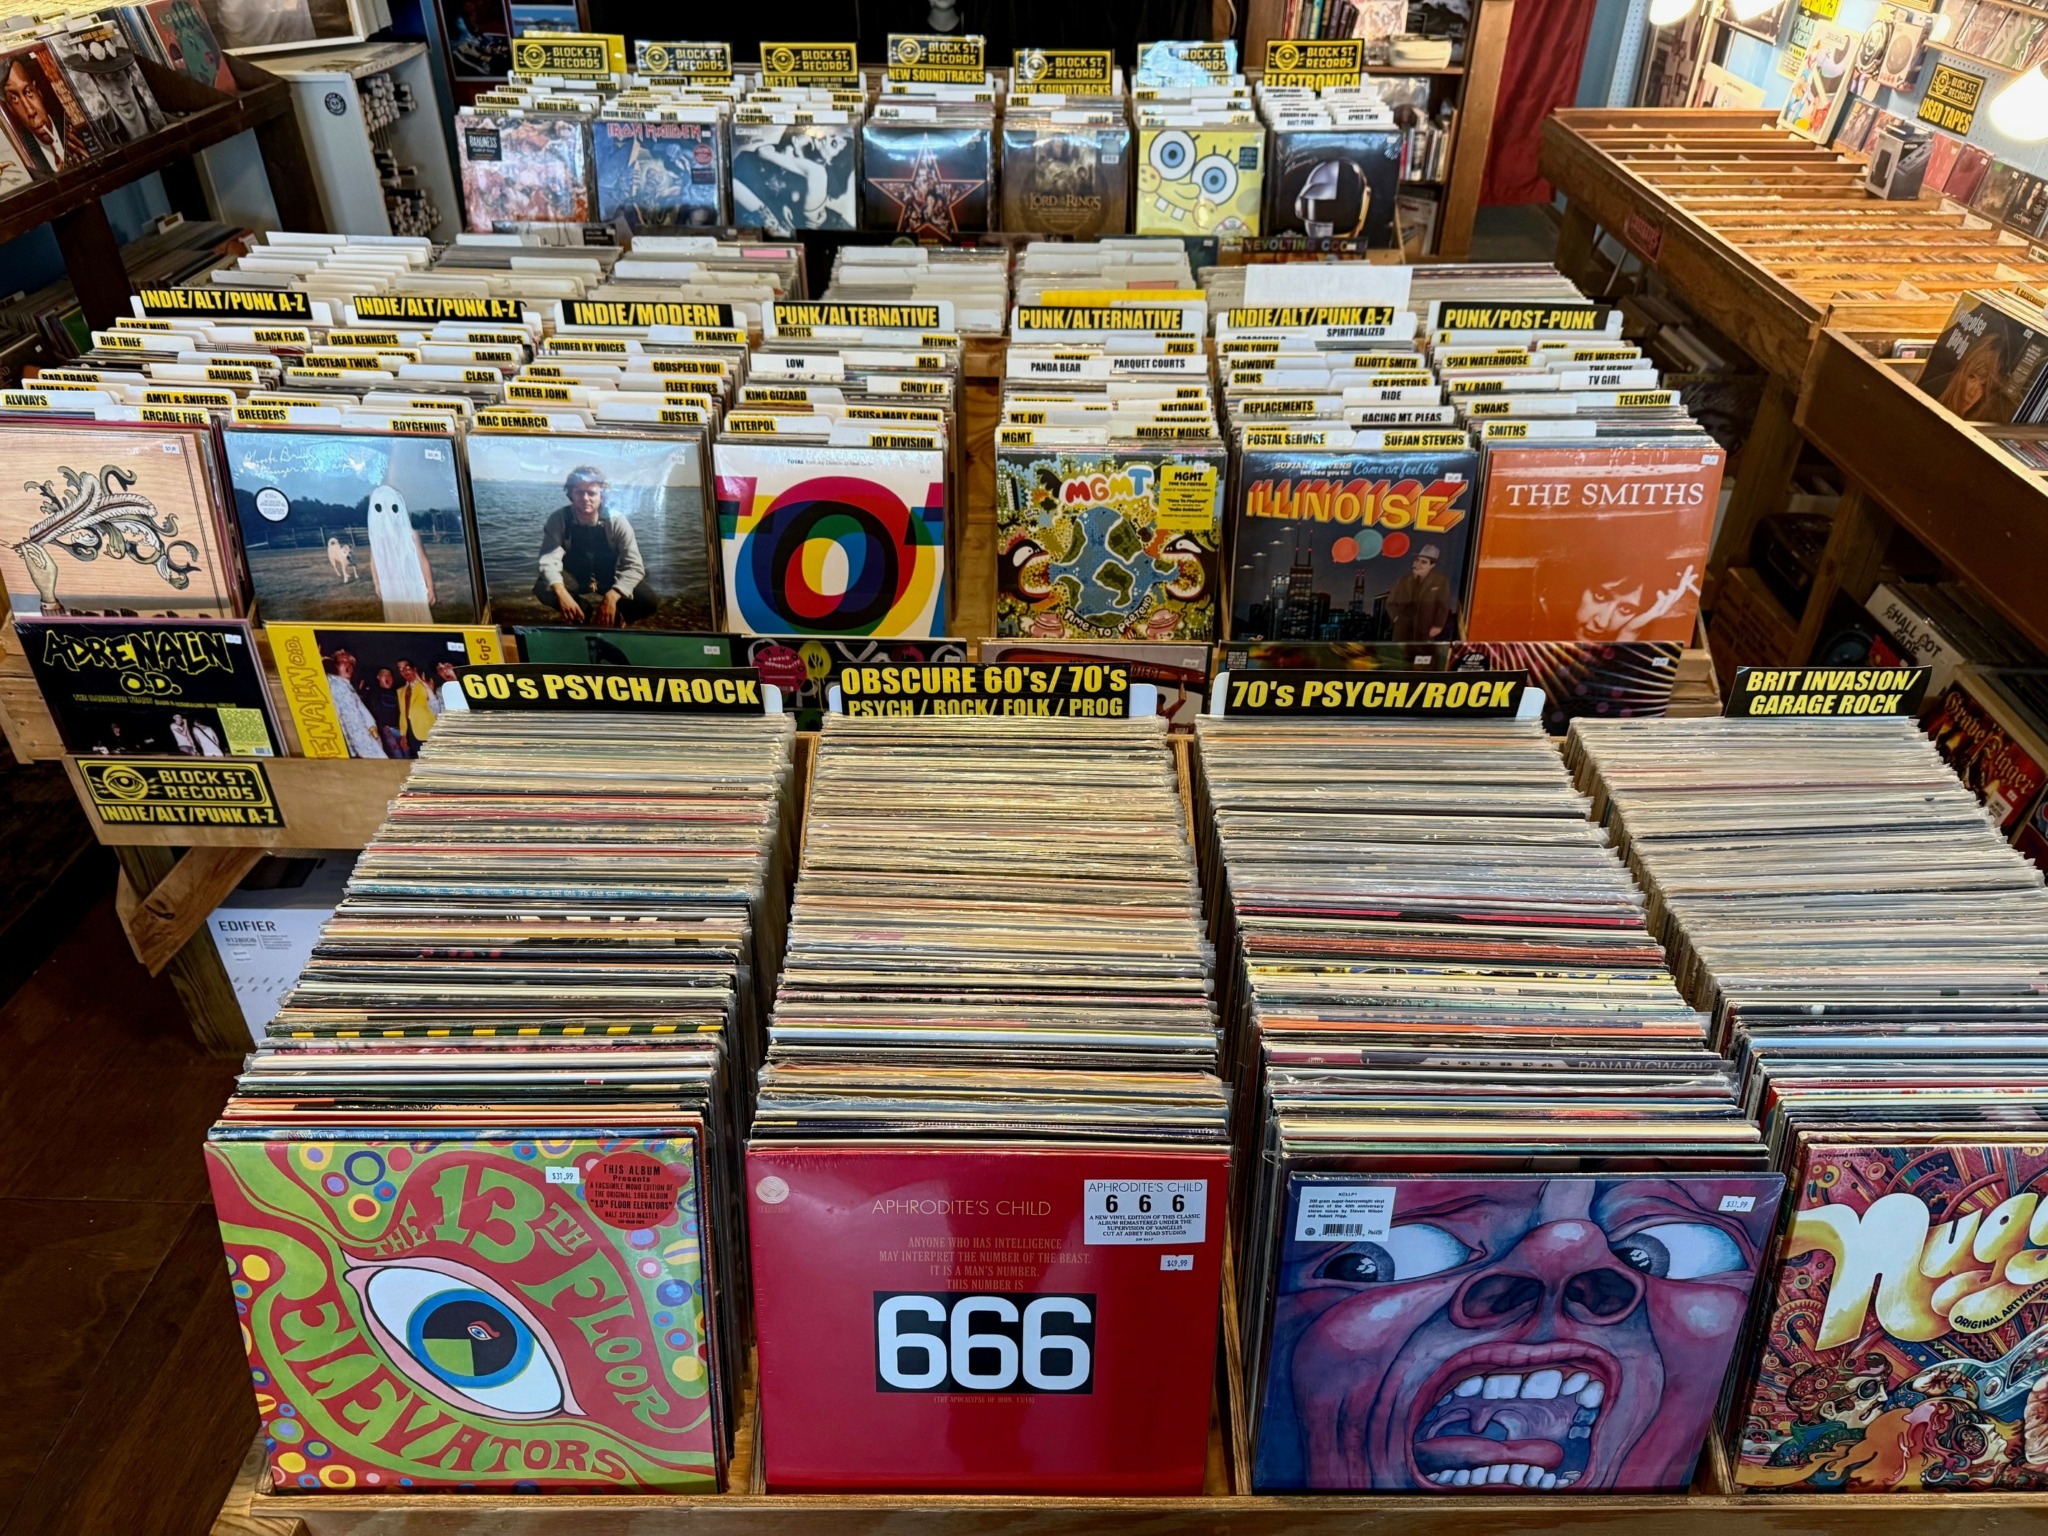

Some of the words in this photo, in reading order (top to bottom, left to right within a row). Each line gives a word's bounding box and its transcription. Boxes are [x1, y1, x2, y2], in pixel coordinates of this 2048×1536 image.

[553, 47, 584, 58] BLOCK
[585, 48, 600, 58] ST.
[676, 48, 709, 60] BLOCK
[710, 49, 725, 60] ST.
[802, 50, 834, 60] BLOCK
[835, 50, 850, 61] ST.
[1306, 46, 1338, 58] BLOCK
[1339, 46, 1356, 57] ST.
[553, 57, 600, 68] RECORDS
[676, 60, 724, 71] RECORDS
[803, 60, 849, 71] RECORDS
[928, 54, 977, 65] RECORDS
[1306, 58, 1354, 69] RECORDS
[888, 69, 911, 80] NEW
[913, 70, 984, 83] SOUNDTRACKS
[1055, 68, 1104, 79] RECORDS
[1264, 73, 1360, 88] ELECTRONICA
[1015, 84, 1039, 95] NEW
[1039, 84, 1111, 95] SOUNDTRACKS
[1948, 87, 1974, 105] RECORDS
[1919, 97, 1945, 124] USED
[1941, 103, 1973, 135] TAPES
[607, 123, 643, 142] IRON
[645, 123, 702, 144] MAIDEN
[140, 290, 276, 312] INDIE/ALT/PUNK
[279, 293, 306, 312] A-Z
[355, 296, 488, 317] INDIE/ALT/PUNK
[490, 299, 518, 319] A-Z
[574, 302, 721, 326] INDIE/MODERN
[775, 306, 938, 327] PUNK/ALTERNATIVE
[1019, 310, 1182, 329] PUNK/ALTERNATIVE
[1229, 308, 1363, 327] INDIE/ALT/PUNK
[1364, 308, 1393, 326] A-Z
[1444, 309, 1597, 329] PUNK/POST-PUNK
[255, 331, 283, 341] BLACK
[285, 332, 305, 342] FLAG
[777, 327, 812, 337] MISFITS
[1327, 327, 1386, 337] SPIRITUALIZED
[331, 335, 353, 345] DEAD
[354, 334, 398, 345] KENNEDYS
[468, 334, 495, 343] DEATH
[497, 335, 523, 344] GRIPS
[550, 342, 580, 351] GUIDED
[582, 343, 593, 351] BY
[595, 343, 626, 352] VOICES
[1167, 343, 1195, 353] PIXIES
[307, 357, 347, 368] COCTEAU
[349, 358, 379, 368] TWINS
[475, 352, 512, 361] DAMNED
[653, 363, 698, 373] GODSPEED
[700, 363, 721, 374] YOU!
[786, 358, 805, 369] LOW
[1031, 362, 1058, 372] PANDA
[1060, 363, 1081, 373] BEAR
[1114, 359, 1150, 369] PARQUET
[1152, 359, 1186, 369] COURTS
[1355, 358, 1388, 368] ELLIOTT
[1389, 358, 1418, 368] SMITH
[208, 369, 252, 381] BAUHAUS
[465, 371, 495, 382] CLASH
[1234, 373, 1262, 383] SHINS
[510, 387, 546, 398] FATHER
[547, 389, 568, 400] JOHN
[665, 382, 689, 392] FLEET
[691, 383, 718, 393] FOXES
[745, 390, 767, 401] KING
[768, 390, 807, 401] GIZZARD
[1381, 390, 1402, 401] RIDE
[1618, 393, 1672, 405] TELEVISION
[1244, 401, 1313, 413] REPLACEMENTS
[1473, 402, 1509, 413] SWANS
[142, 411, 182, 422] ARCADE
[183, 412, 204, 424] FIRE
[237, 409, 286, 420] BREEDERS
[662, 411, 699, 422] DUSTER
[392, 420, 447, 432] BOYGENIUS
[478, 415, 499, 426] MAC
[501, 416, 548, 428] DEMARCO
[730, 420, 776, 431] INTERPOL
[1487, 425, 1526, 436] SMITHS
[1002, 432, 1032, 444] MGMT
[1247, 434, 1283, 445] POSTAL
[1284, 433, 1325, 445] SERVICE
[1384, 435, 1420, 446] SUFJAN
[1421, 434, 1465, 445] STEVENS
[1064, 467, 1153, 504] MGMT
[1505, 483, 1571, 506] THE
[1581, 482, 1704, 506] SMITHS
[1246, 478, 1469, 534] ILLINOISE
[1063, 607, 1090, 632] TIME
[1097, 626, 1113, 638] TO
[1118, 596, 1152, 633] PRETEND
[120, 671, 183, 696] O.D.
[841, 666, 977, 695] OBSCURE
[1068, 665, 1127, 693] 70's
[1746, 670, 1802, 692] BRIT
[1801, 669, 1923, 692] INVASION/
[462, 672, 539, 700] 60's
[543, 674, 760, 705] PSYCH/ROCK
[1232, 680, 1295, 708] 70's
[1300, 680, 1516, 709] PSYCH/ROCK
[848, 699, 915, 717] PSYCH
[1003, 698, 1050, 717] FOLK
[1069, 697, 1123, 717] PROG
[1749, 694, 1837, 715] GARAGE
[1836, 693, 1903, 715] ROCK
[158, 770, 224, 785] BLOCK
[224, 771, 254, 785] ST.
[164, 786, 255, 800] RECORDS
[98, 805, 247, 823] INDIE/ALT/PUNK
[249, 808, 279, 824] A-Z
[218, 920, 277, 932] EDIFIER
[603, 1164, 624, 1175] THIS
[628, 1165, 661, 1176] ALBUM
[1088, 1182, 1164, 1193] APHRODITE'S
[1167, 1182, 1203, 1193] CHILD
[872, 1199, 990, 1216] APHRODITE'S
[995, 1200, 1051, 1216] CHILD
[1105, 1194, 1119, 1214] 6
[1138, 1194, 1152, 1214] 6
[1171, 1194, 1185, 1214] 6
[374, 1199, 430, 1256] THE
[908, 1237, 946, 1248] ANYONE
[948, 1237, 970, 1248] WHO
[973, 1237, 991, 1249] HAS
[994, 1238, 1062, 1249] INTELLIGENCE
[879, 1251, 899, 1262] MAY
[902, 1251, 957, 1262] INTERPRET
[958, 1252, 977, 1263] THE
[979, 1252, 1020, 1263] NUMBER
[1022, 1252, 1035, 1264] OF
[1037, 1253, 1057, 1264] THE
[1059, 1253, 1091, 1264] BEAST.
[1166, 1259, 1188, 1268] $49.99
[946, 1279, 968, 1290] THIS
[971, 1279, 1011, 1291] NUMBER
[1013, 1280, 1024, 1291] IS
[512, 1248, 673, 1429] FLOOR
[878, 1295, 1092, 1391] 666
[279, 1300, 630, 1480] ELEVATORS
